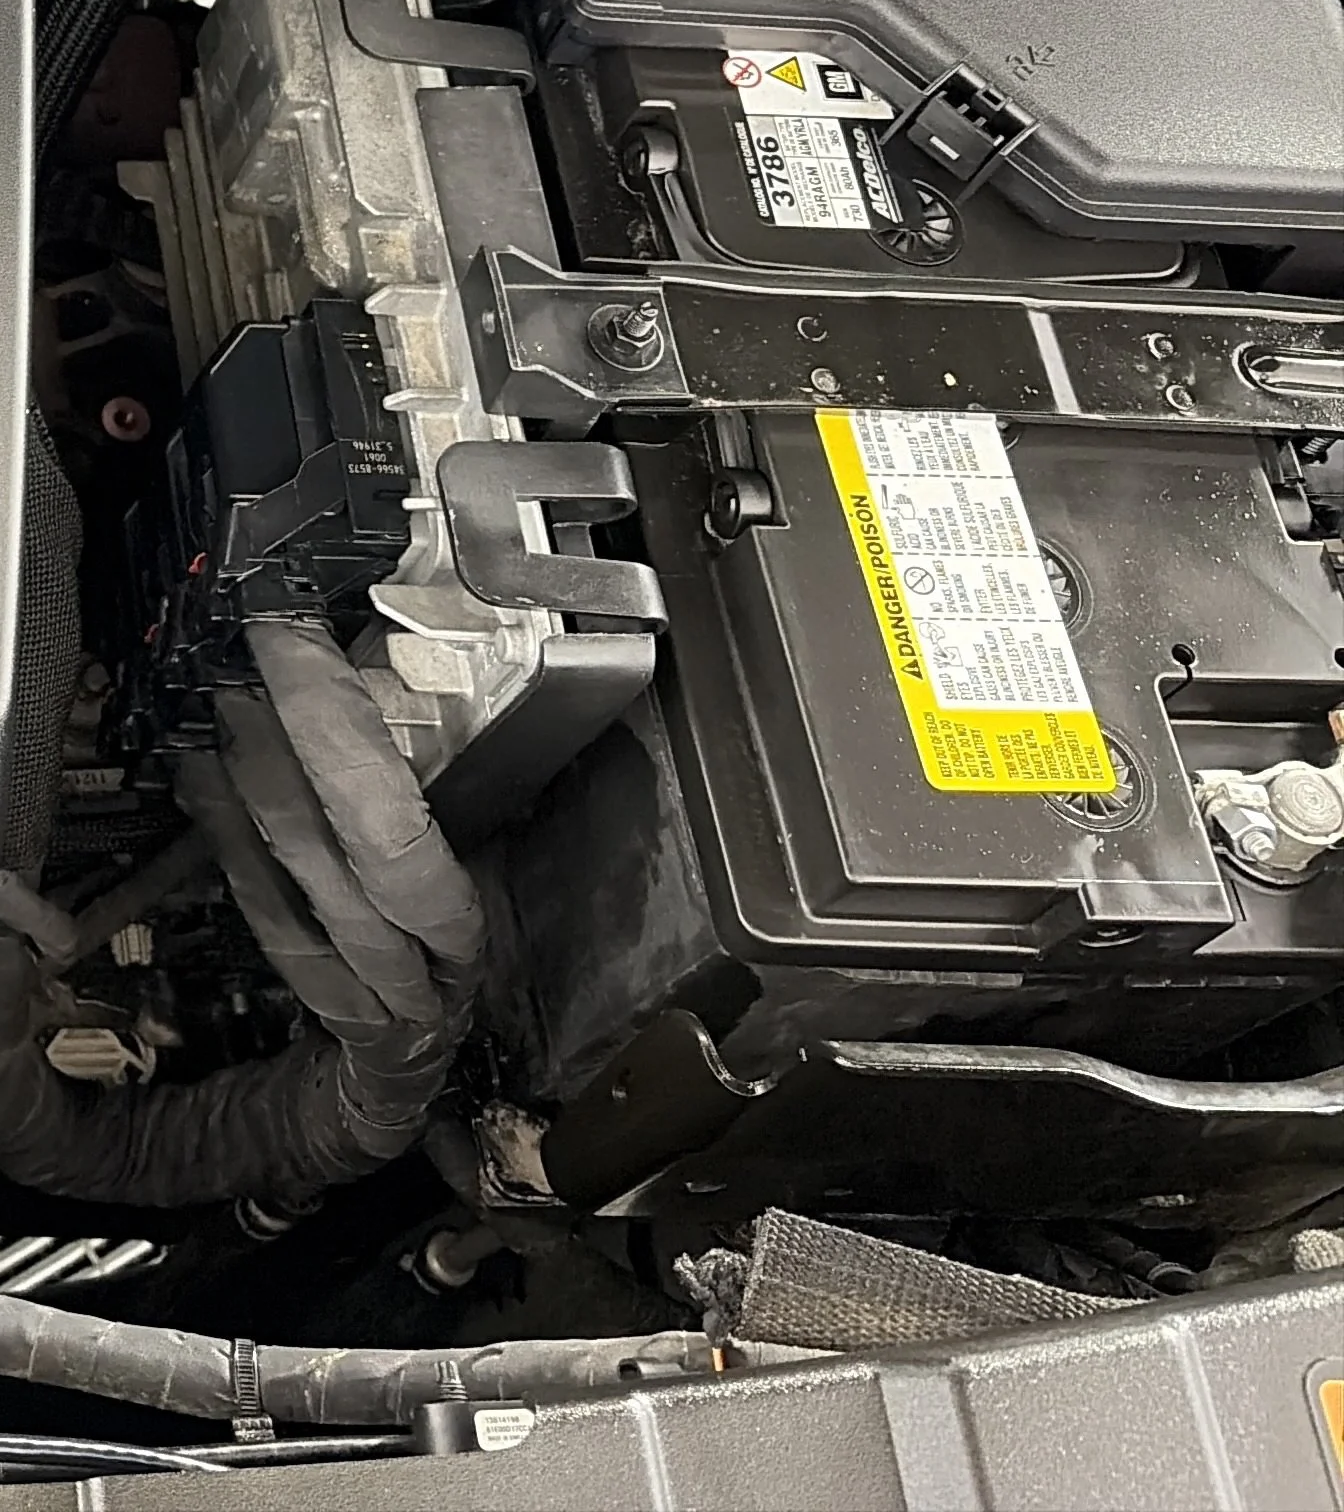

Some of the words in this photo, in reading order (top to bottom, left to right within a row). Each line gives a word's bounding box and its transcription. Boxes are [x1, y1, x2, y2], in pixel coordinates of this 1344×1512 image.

[822, 70, 850, 92] GM
[756, 136, 795, 207] 3786
[805, 166, 831, 217] 94RAGM
[853, 129, 890, 217] ACDelco
[849, 204, 864, 222] 730
